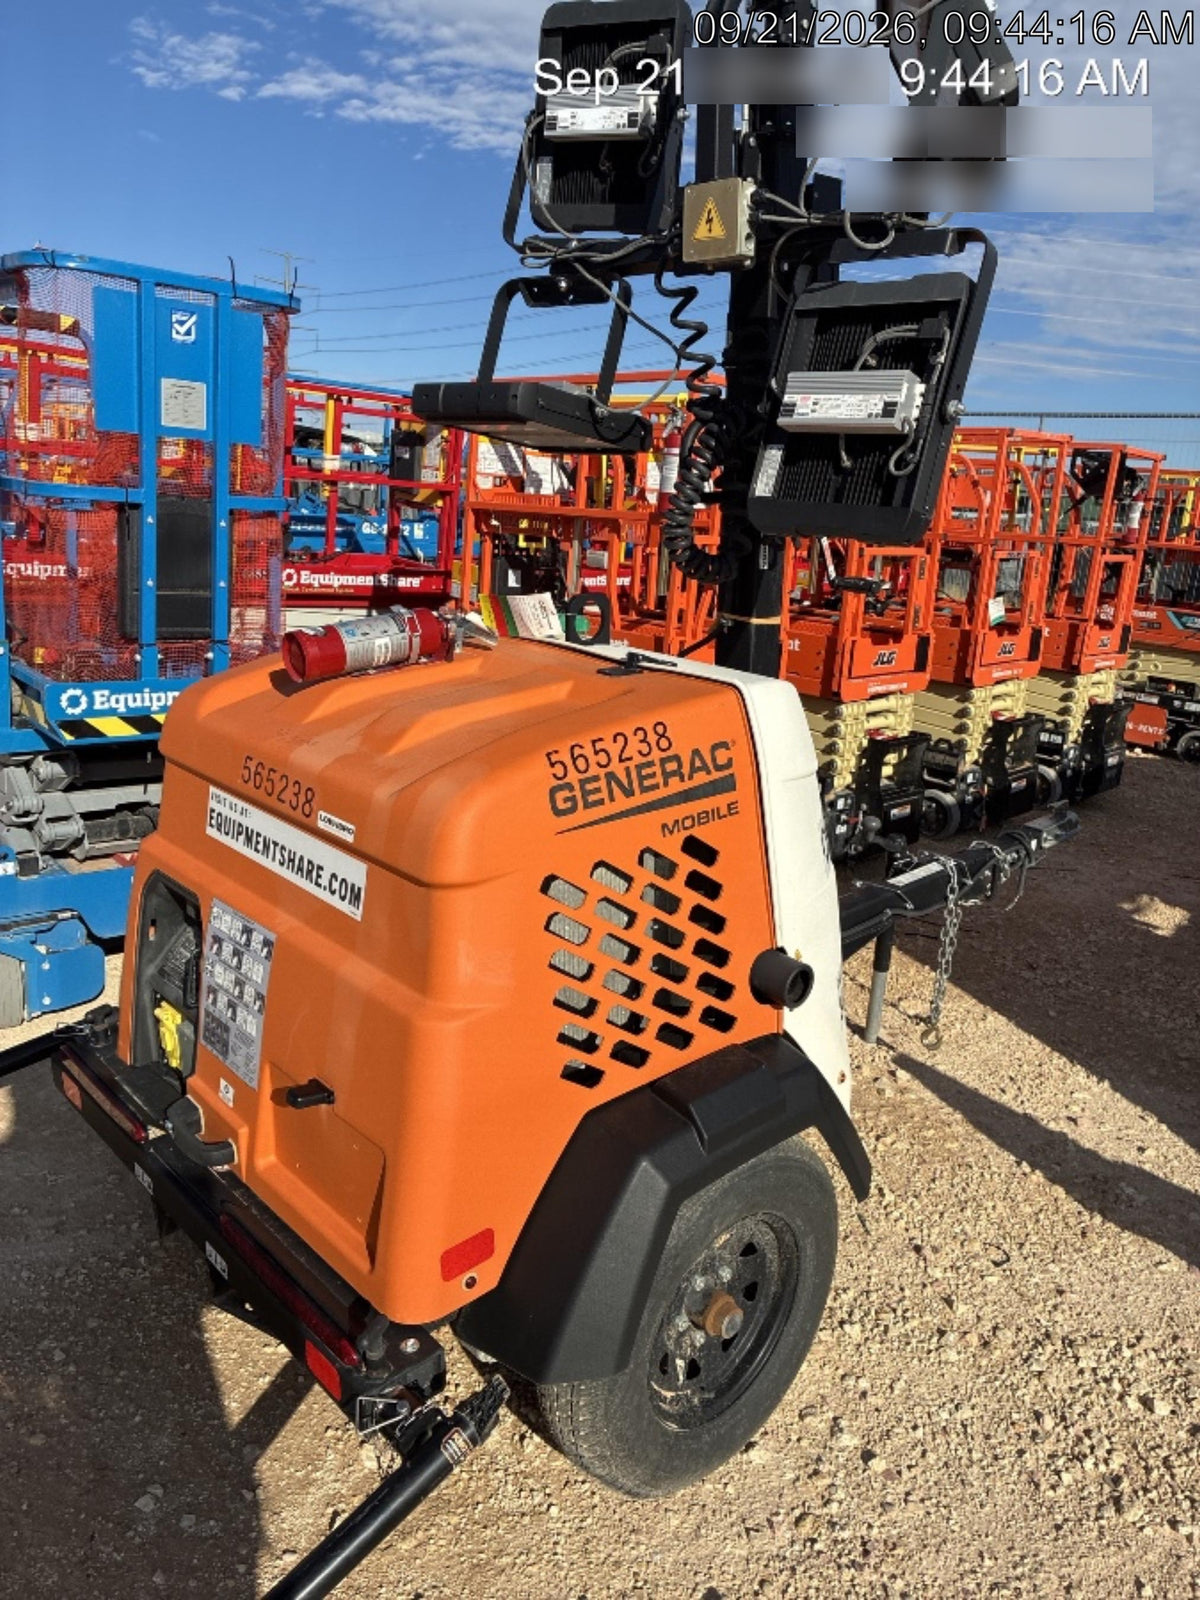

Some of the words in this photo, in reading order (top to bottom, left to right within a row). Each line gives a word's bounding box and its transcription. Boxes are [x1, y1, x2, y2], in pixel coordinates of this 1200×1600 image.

[872, 650, 897, 666] JLG
[545, 720, 673, 781] 565238
[549, 740, 734, 818] GENERAC
[241, 755, 315, 818] 565238
[660, 800, 740, 838] MOBILE
[209, 807, 363, 911] EQUIPMENTSHARE.COM
